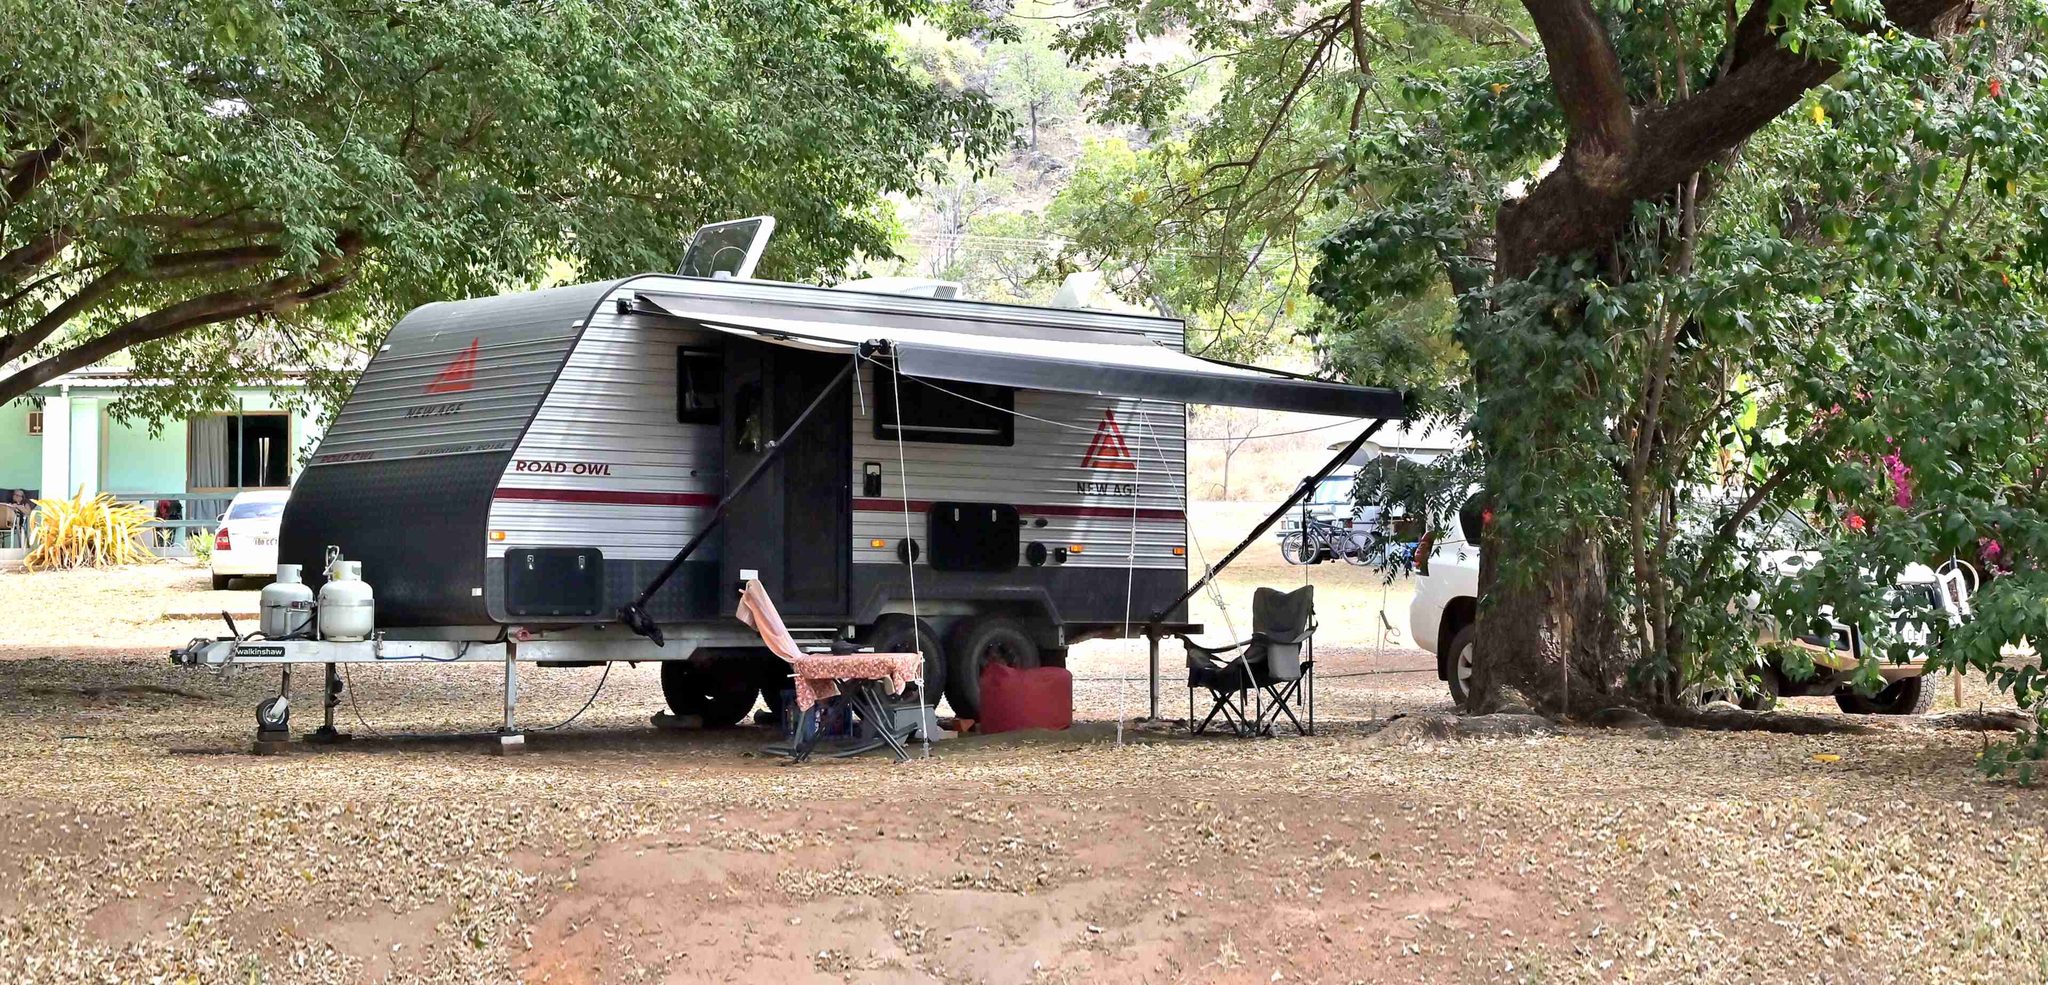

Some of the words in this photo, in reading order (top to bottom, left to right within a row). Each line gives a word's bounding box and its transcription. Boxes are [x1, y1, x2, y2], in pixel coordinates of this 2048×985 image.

[515, 460, 567, 474] ROAD
[572, 462, 612, 476] OWL
[1076, 481, 1108, 496] NEW
[237, 647, 283, 656] walkinshaw
